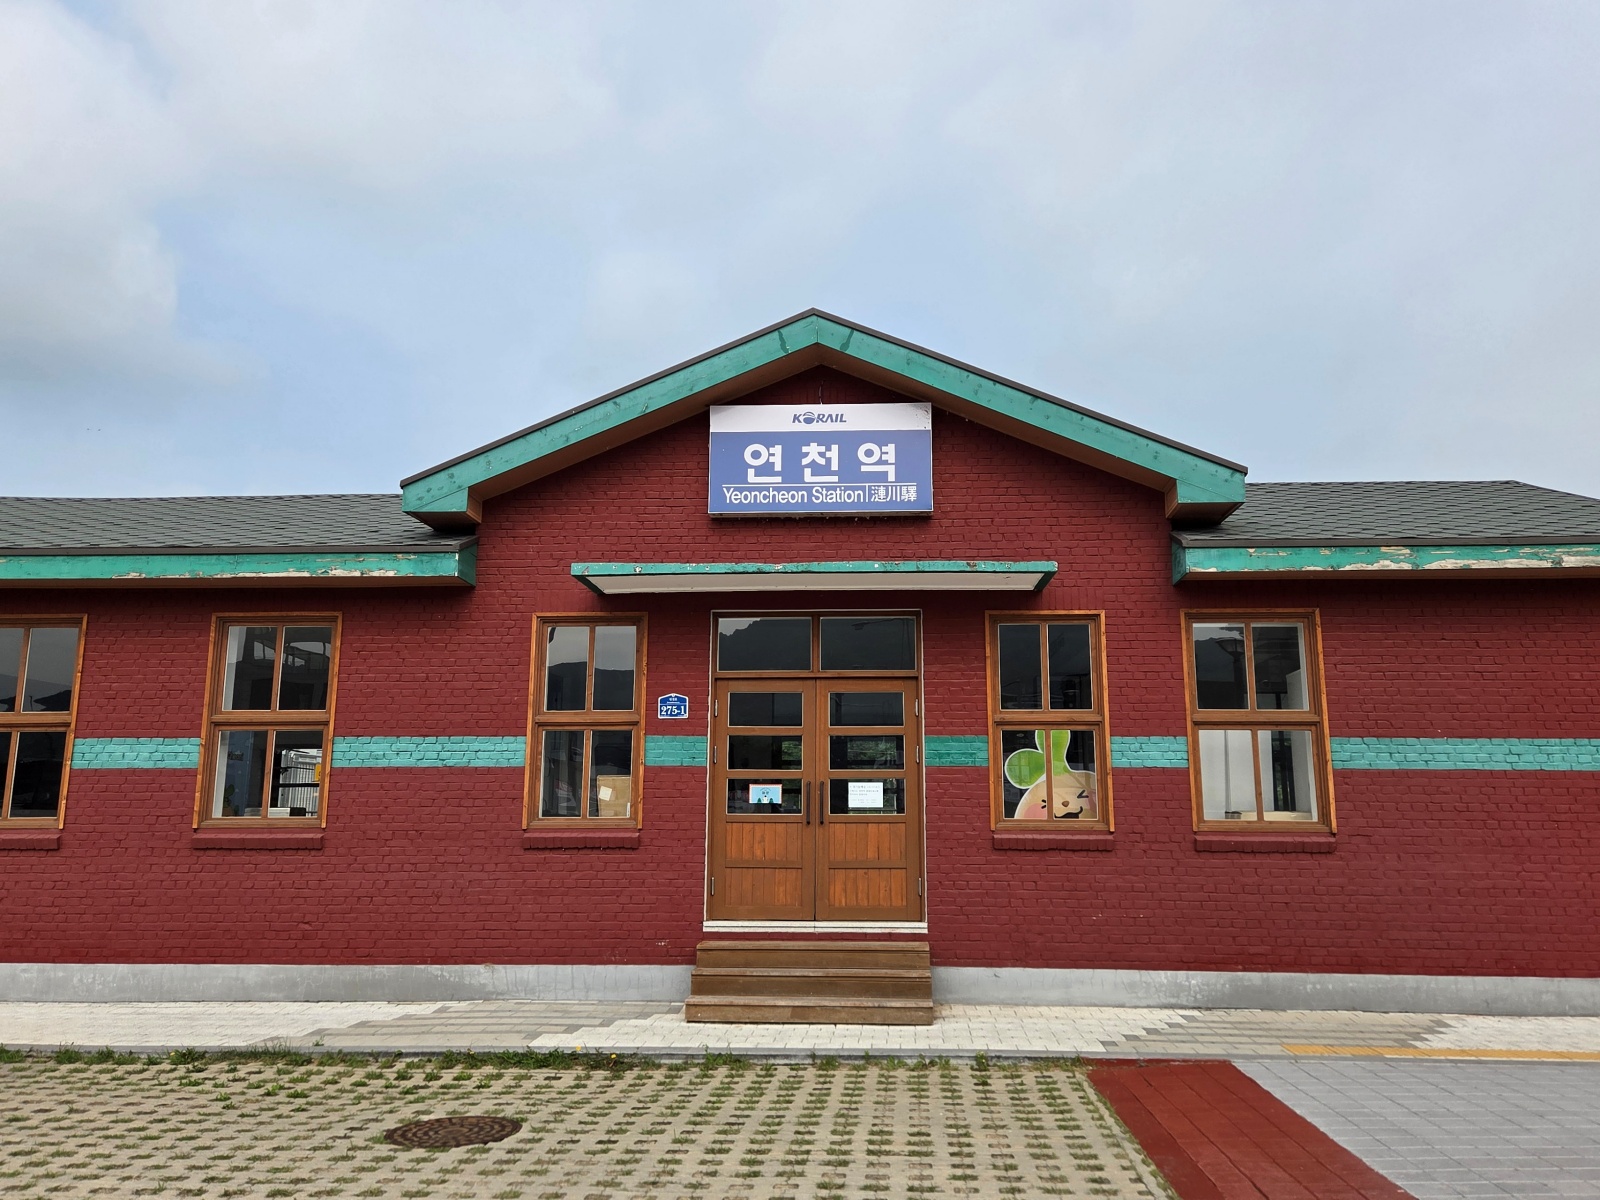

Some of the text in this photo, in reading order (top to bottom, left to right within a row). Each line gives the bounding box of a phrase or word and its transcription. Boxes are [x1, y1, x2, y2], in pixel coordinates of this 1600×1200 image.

[792, 411, 847, 425] KORAIL
[723, 486, 863, 504] Yeoncheon Station
[661, 705, 685, 715] 275-1
